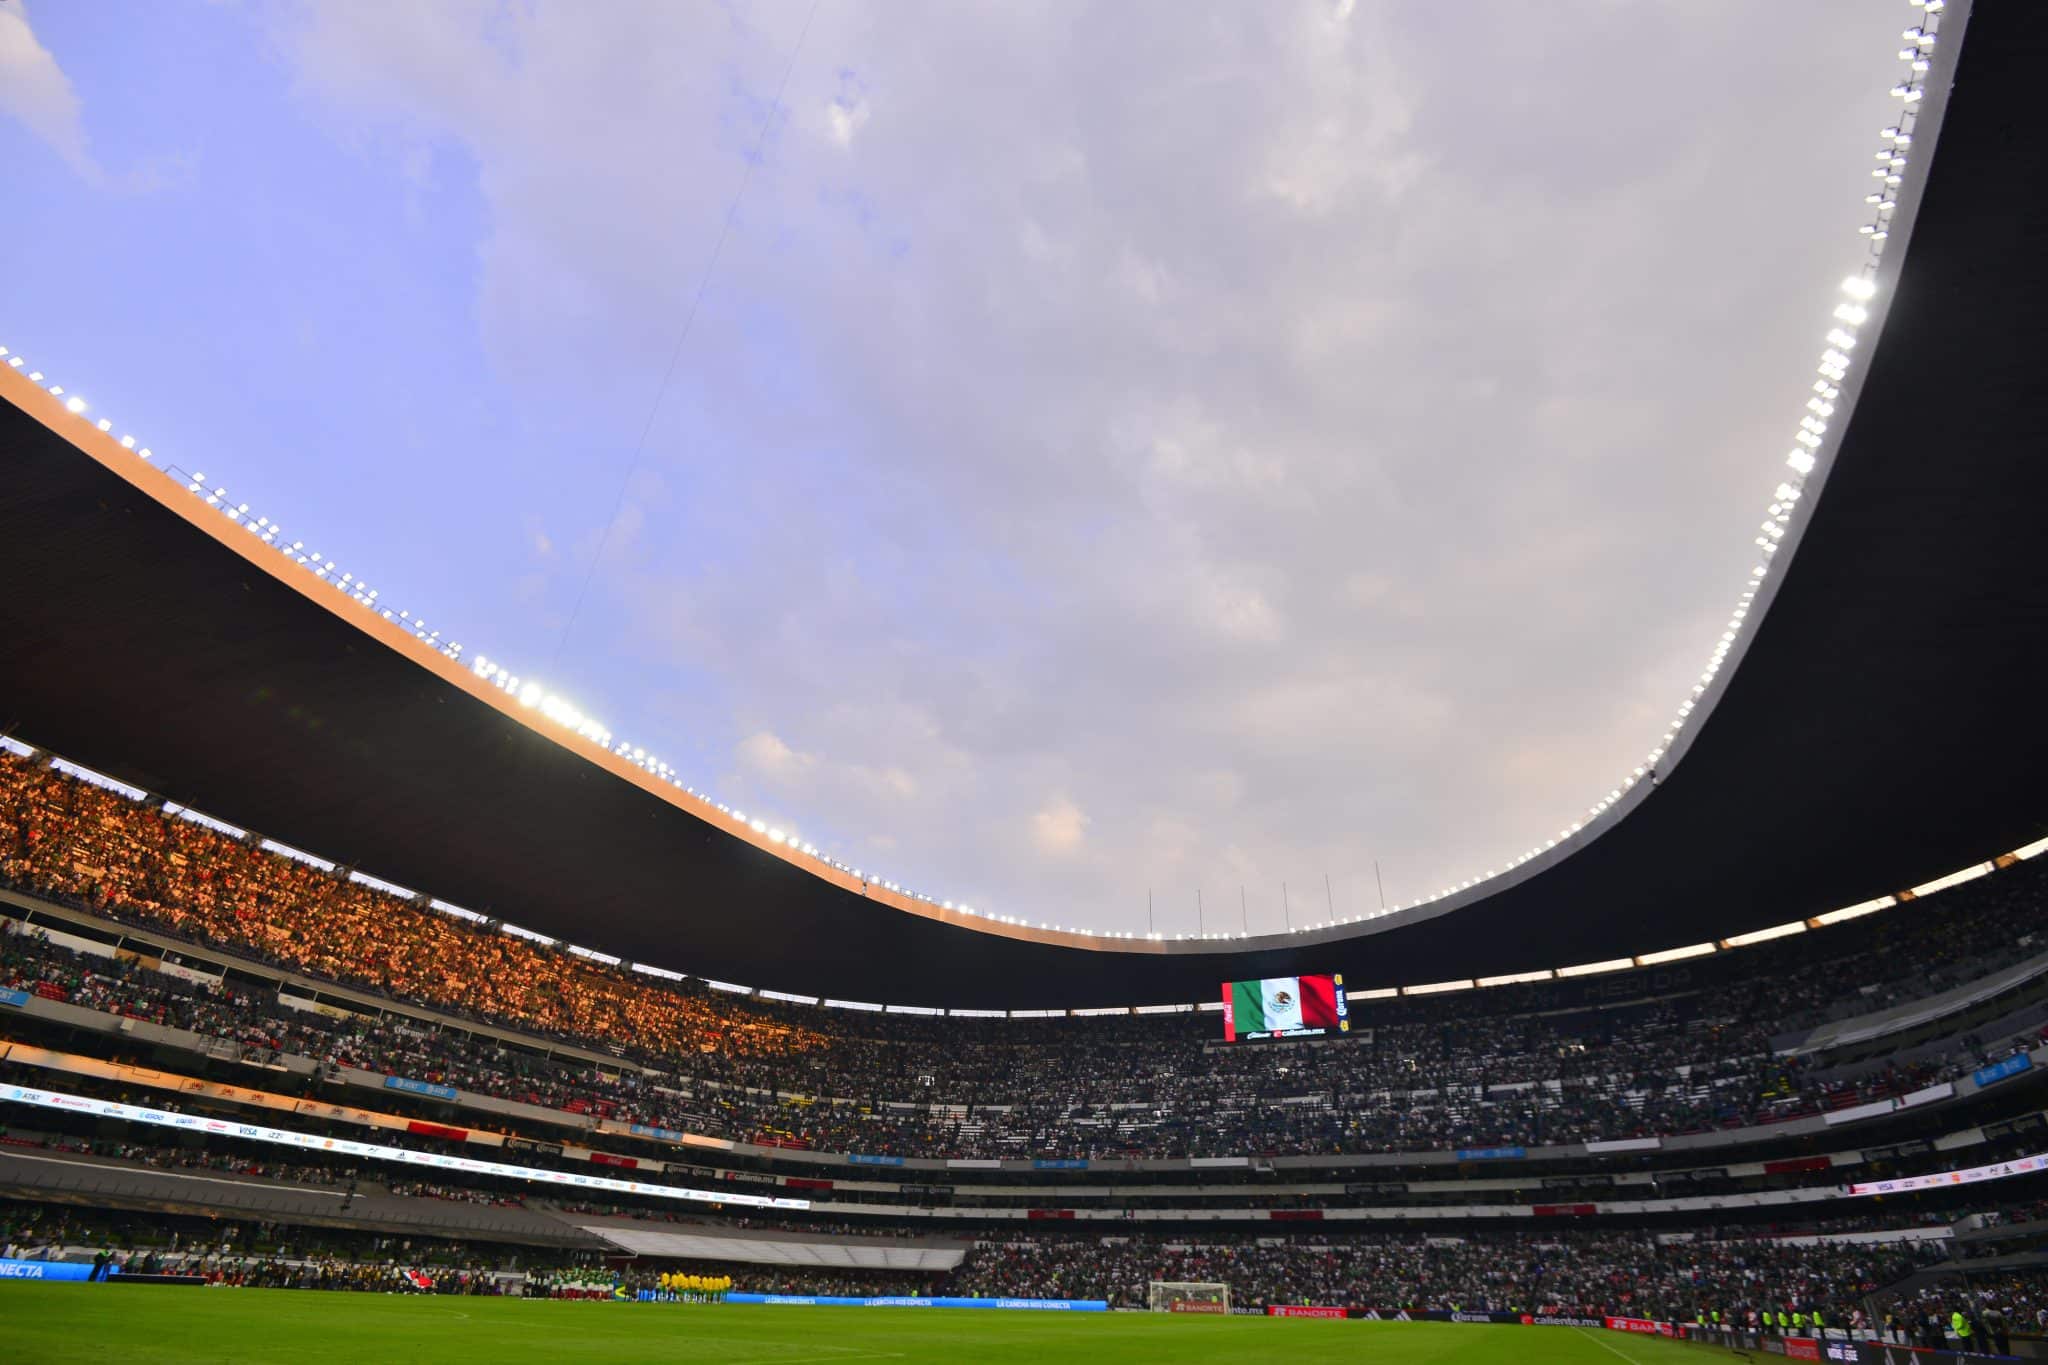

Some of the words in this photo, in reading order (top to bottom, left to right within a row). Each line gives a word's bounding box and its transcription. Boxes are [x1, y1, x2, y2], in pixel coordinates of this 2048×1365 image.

[240, 1126, 257, 1136] VISA
[1289, 1309, 1342, 1318] BANORTE
[1451, 1312, 1490, 1322] Corona
[1534, 1316, 1600, 1328] caliente.mx
